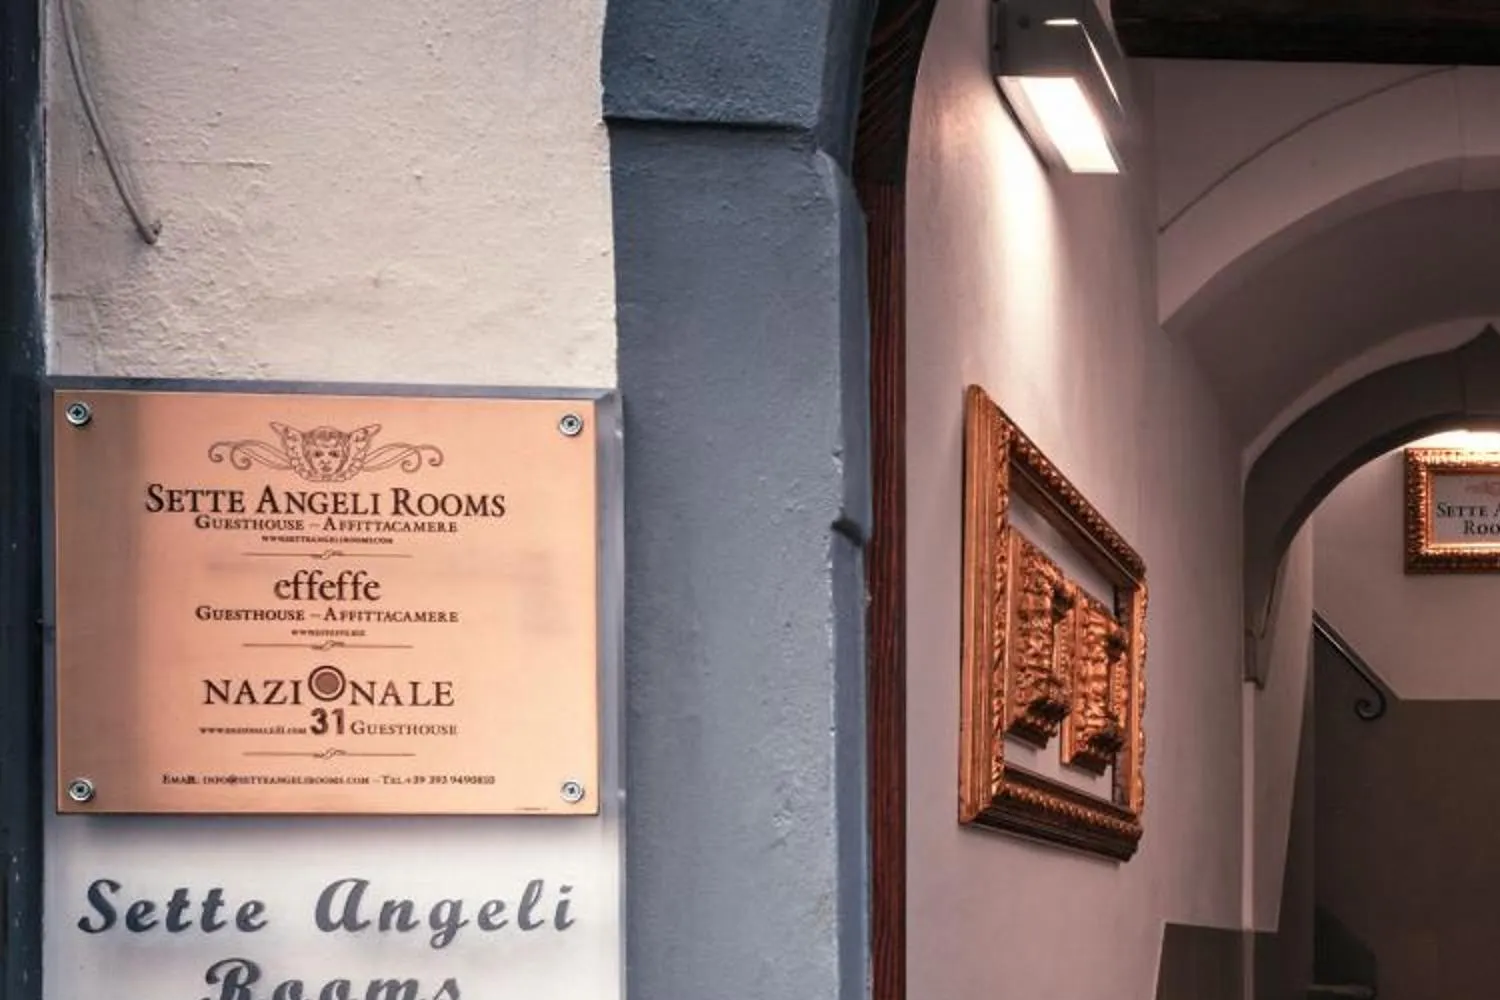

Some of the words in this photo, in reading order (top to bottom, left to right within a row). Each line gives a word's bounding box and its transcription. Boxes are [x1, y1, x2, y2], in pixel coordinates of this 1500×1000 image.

[145, 483, 246, 513] SETTE
[255, 483, 381, 515] ANGELI
[390, 487, 506, 518] ROOMS
[1436, 501, 1489, 518] SETTE
[194, 514, 305, 531] GUESTHOUSE
[322, 517, 458, 533] AFFITTACAMERE
[273, 569, 381, 601] effeffe
[195, 604, 305, 622] GUESTHOUSE
[323, 606, 459, 623] AFFITTACAMERE
[202, 664, 456, 706] NAZIONALE
[310, 707, 345, 735] 31
[350, 719, 457, 736] GUESTHOUSE
[77, 878, 268, 934] Sette
[314, 877, 576, 950] Angeli
